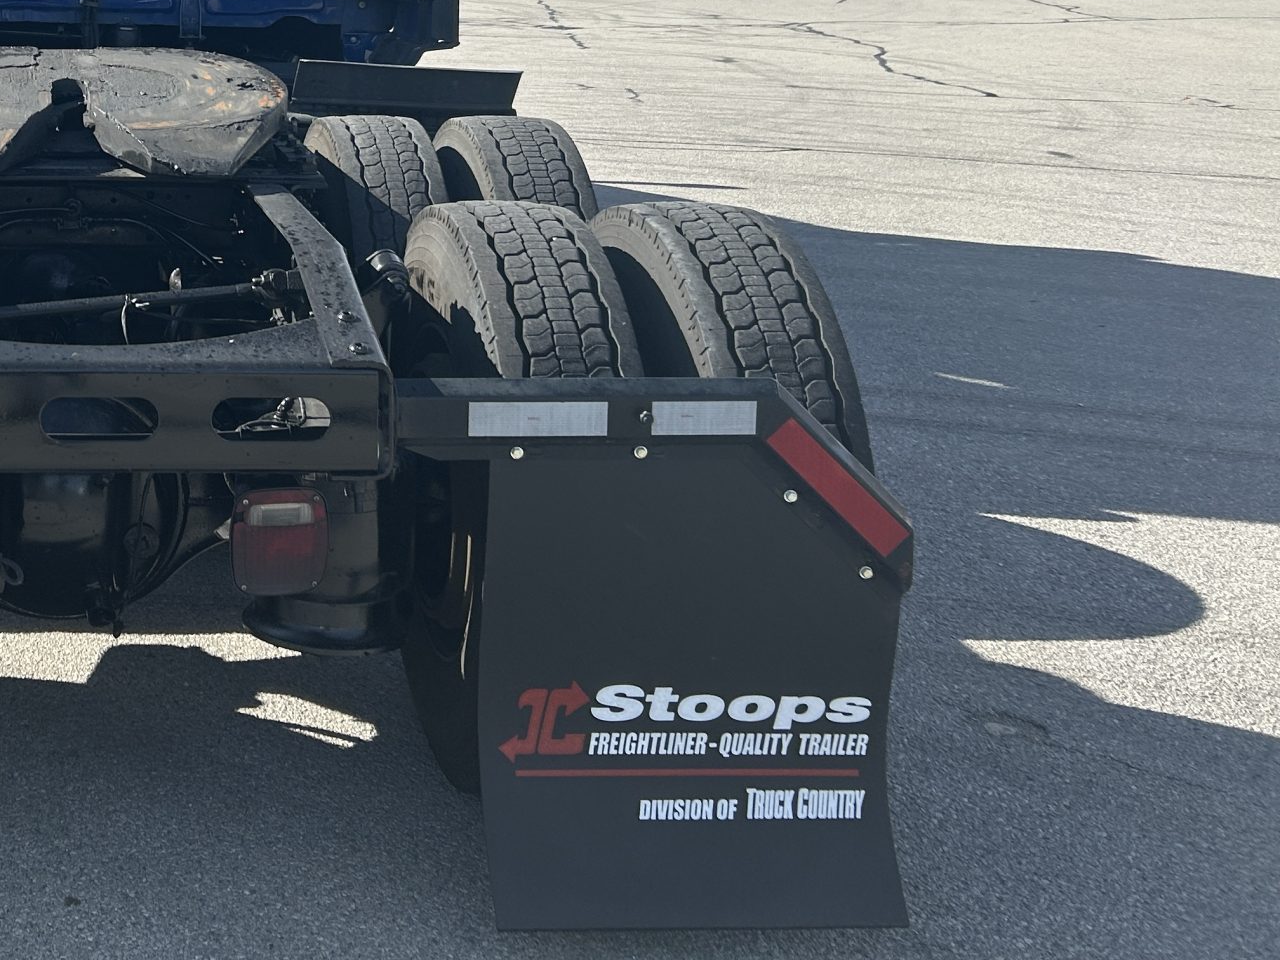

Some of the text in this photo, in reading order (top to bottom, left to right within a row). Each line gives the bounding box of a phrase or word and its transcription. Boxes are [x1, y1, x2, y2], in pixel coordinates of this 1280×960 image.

[591, 685, 872, 729] Stoops
[799, 734, 869, 755] TRAILER
[639, 788, 865, 820] DIVISION OF TRUCK COUNTRY
